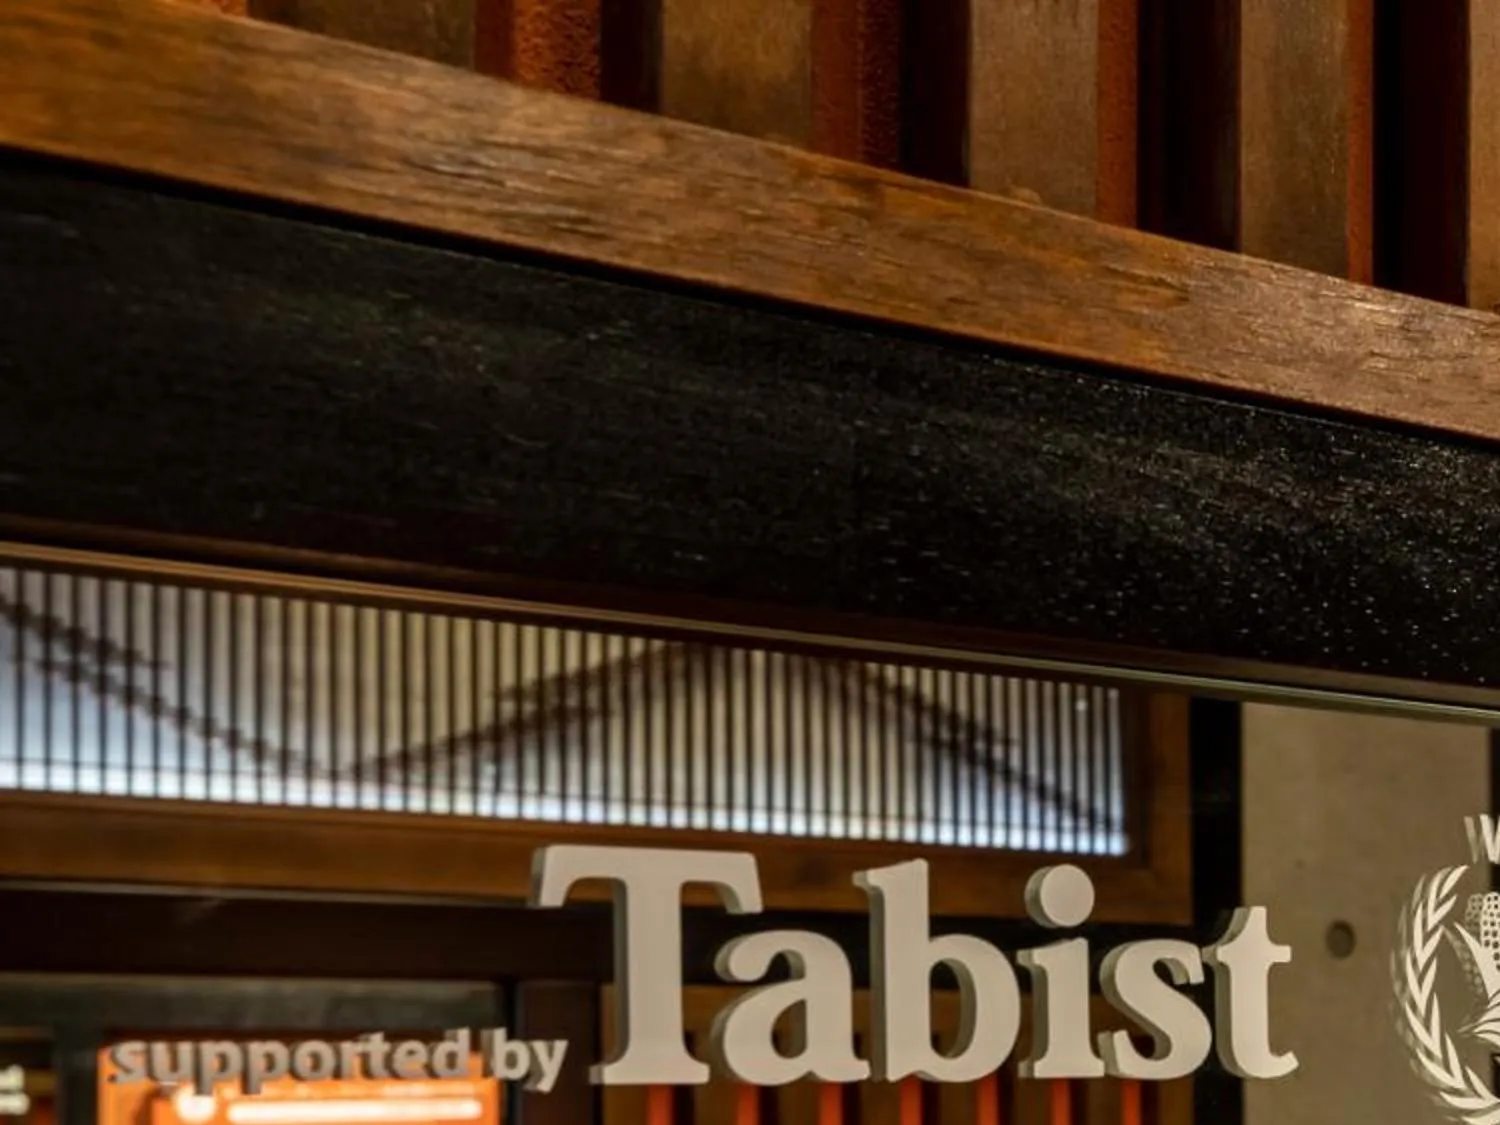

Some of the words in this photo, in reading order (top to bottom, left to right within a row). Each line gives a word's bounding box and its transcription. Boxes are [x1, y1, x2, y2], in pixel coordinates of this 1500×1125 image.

[533, 844, 1299, 1086] Tabist
[110, 1028, 470, 1094] supported
[492, 1027, 568, 1093] by
